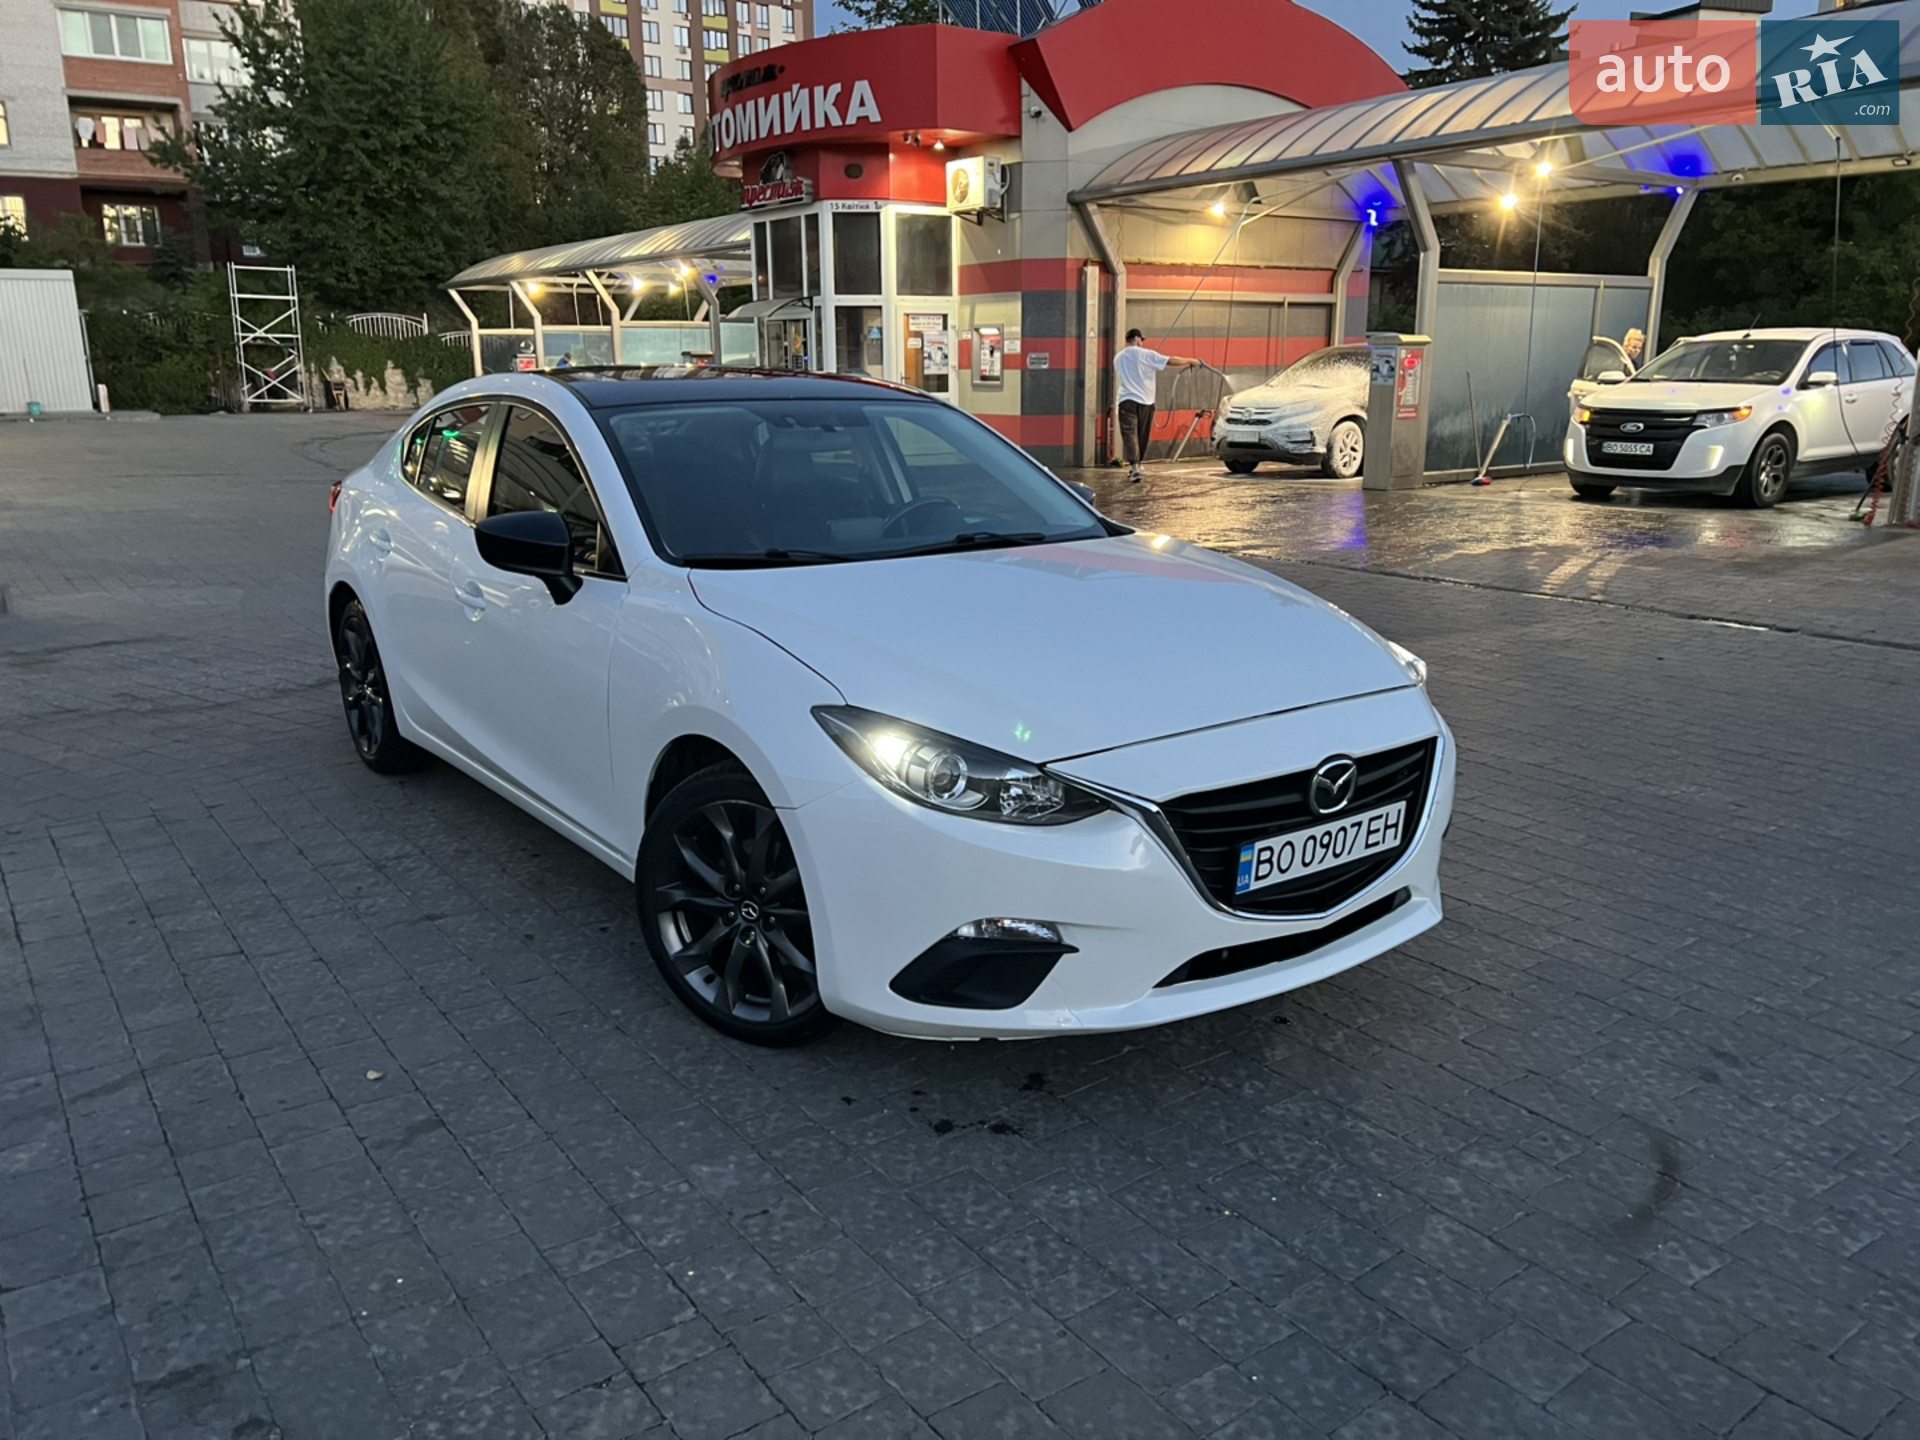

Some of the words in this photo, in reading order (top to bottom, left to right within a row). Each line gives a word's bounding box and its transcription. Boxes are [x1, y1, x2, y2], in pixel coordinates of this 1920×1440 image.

[830, 202, 840, 210] 15
[1254, 840, 1296, 882] BO
[1301, 821, 1363, 867] 0907
[1365, 808, 1402, 849] EH
[1237, 873, 1250, 887] UA
